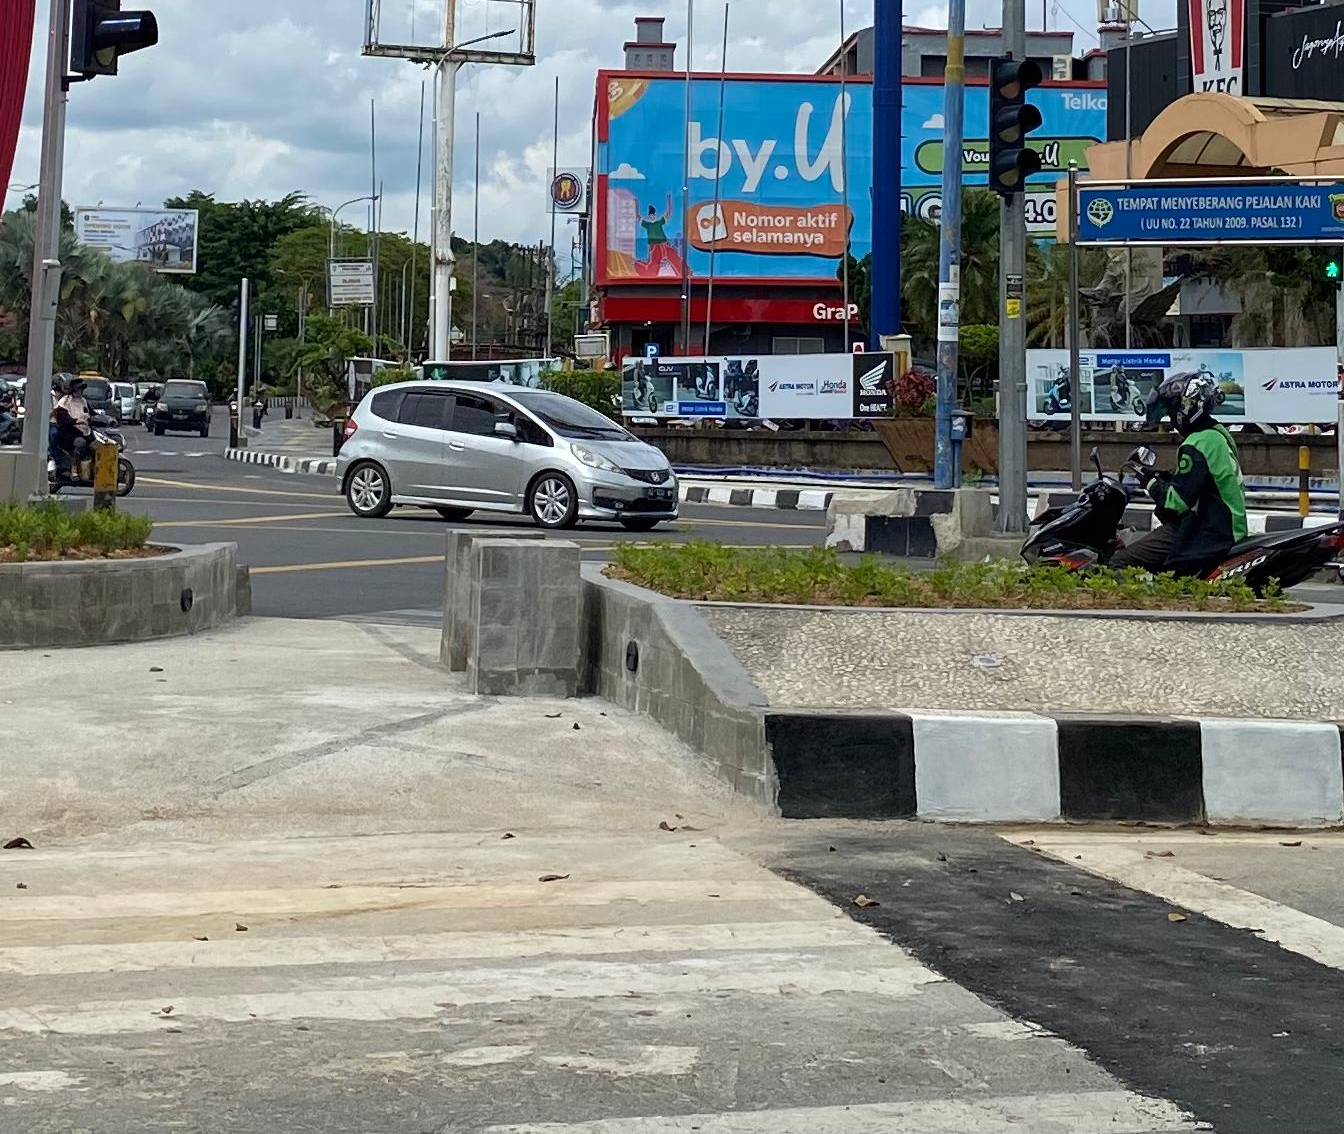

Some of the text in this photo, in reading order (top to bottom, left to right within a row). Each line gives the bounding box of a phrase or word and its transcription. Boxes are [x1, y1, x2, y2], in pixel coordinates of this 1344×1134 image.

[1117, 195, 1321, 210] TEMPAT MENYEBERANG PEJALAN KAKI
[733, 212, 838, 228] Nomor aktif
[1161, 217, 1177, 229] NO.
[1179, 217, 1190, 229] 22
[1193, 217, 1223, 228] TAHUN
[1251, 217, 1278, 228] PASAL
[733, 229, 824, 248] selamanya
[821, 379, 847, 389] Honda
[1279, 380, 1339, 389] ASTRA MOTOR
